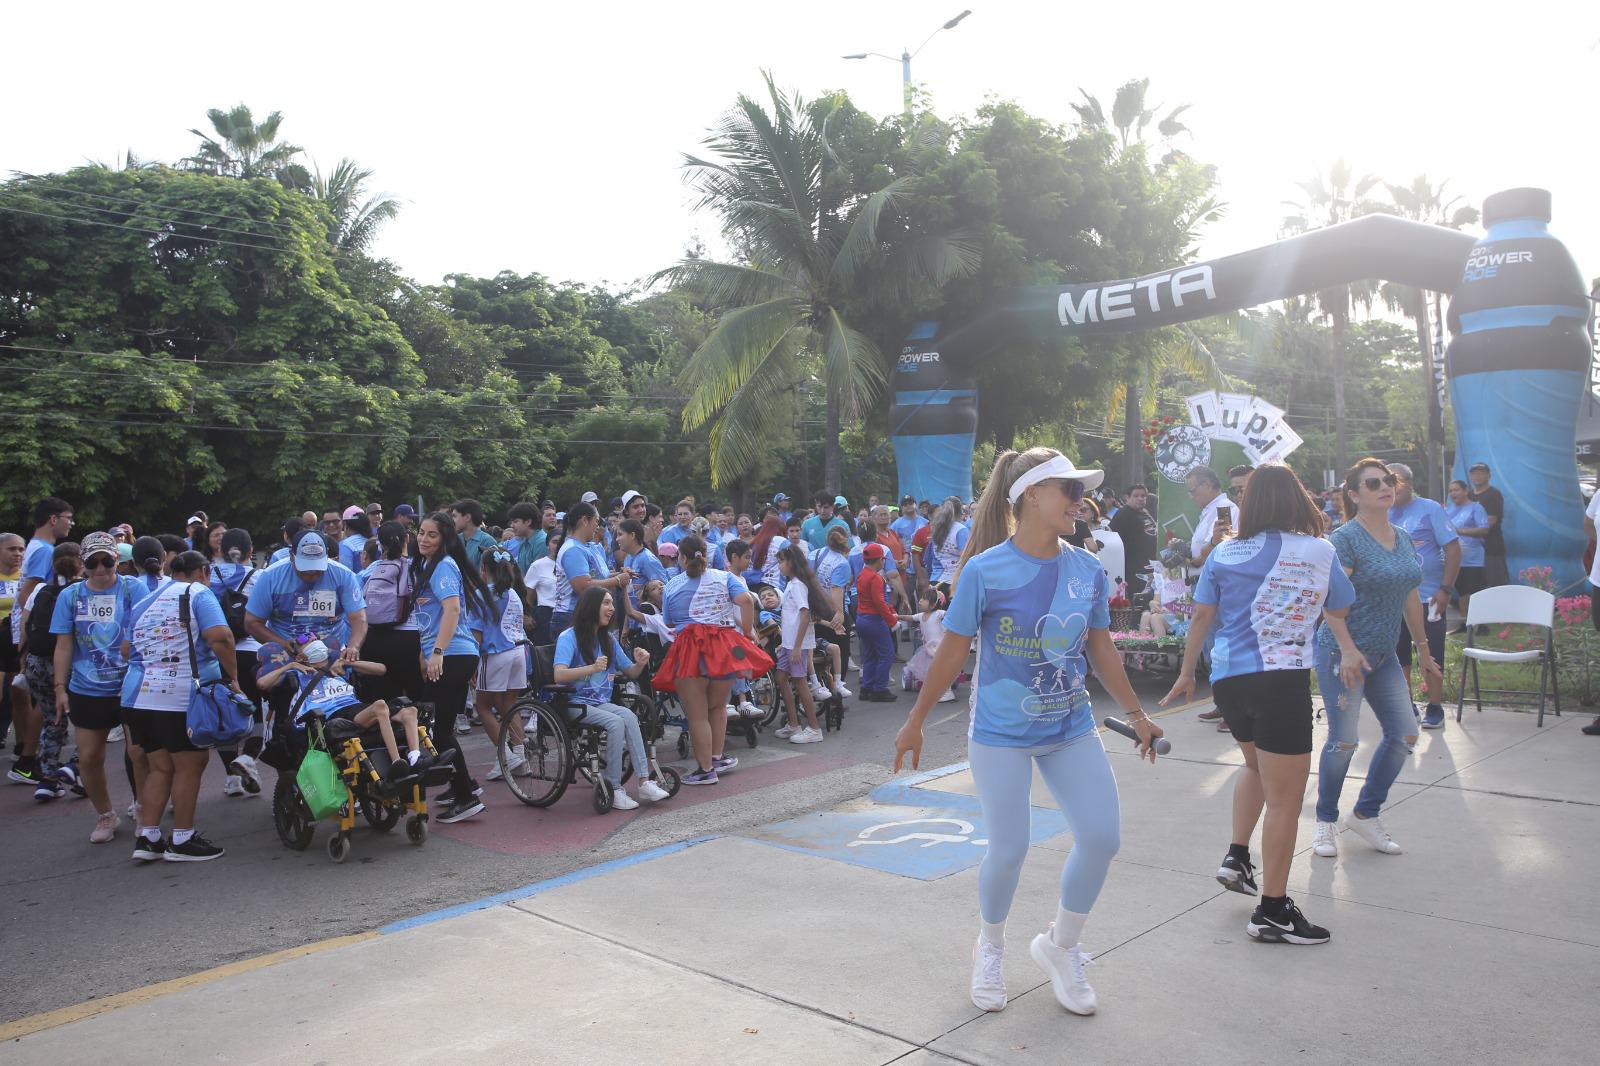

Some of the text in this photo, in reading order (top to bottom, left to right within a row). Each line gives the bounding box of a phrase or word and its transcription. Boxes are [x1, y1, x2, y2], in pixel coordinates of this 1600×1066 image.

[1465, 251, 1533, 270] POWER
[1057, 265, 1217, 327] META
[898, 352, 940, 364] POWER
[1196, 404, 1283, 455] Lupi
[91, 606, 113, 617] 069
[312, 601, 332, 611] 061
[995, 633, 1069, 652] CAMIN
[329, 683, 349, 695] 067
